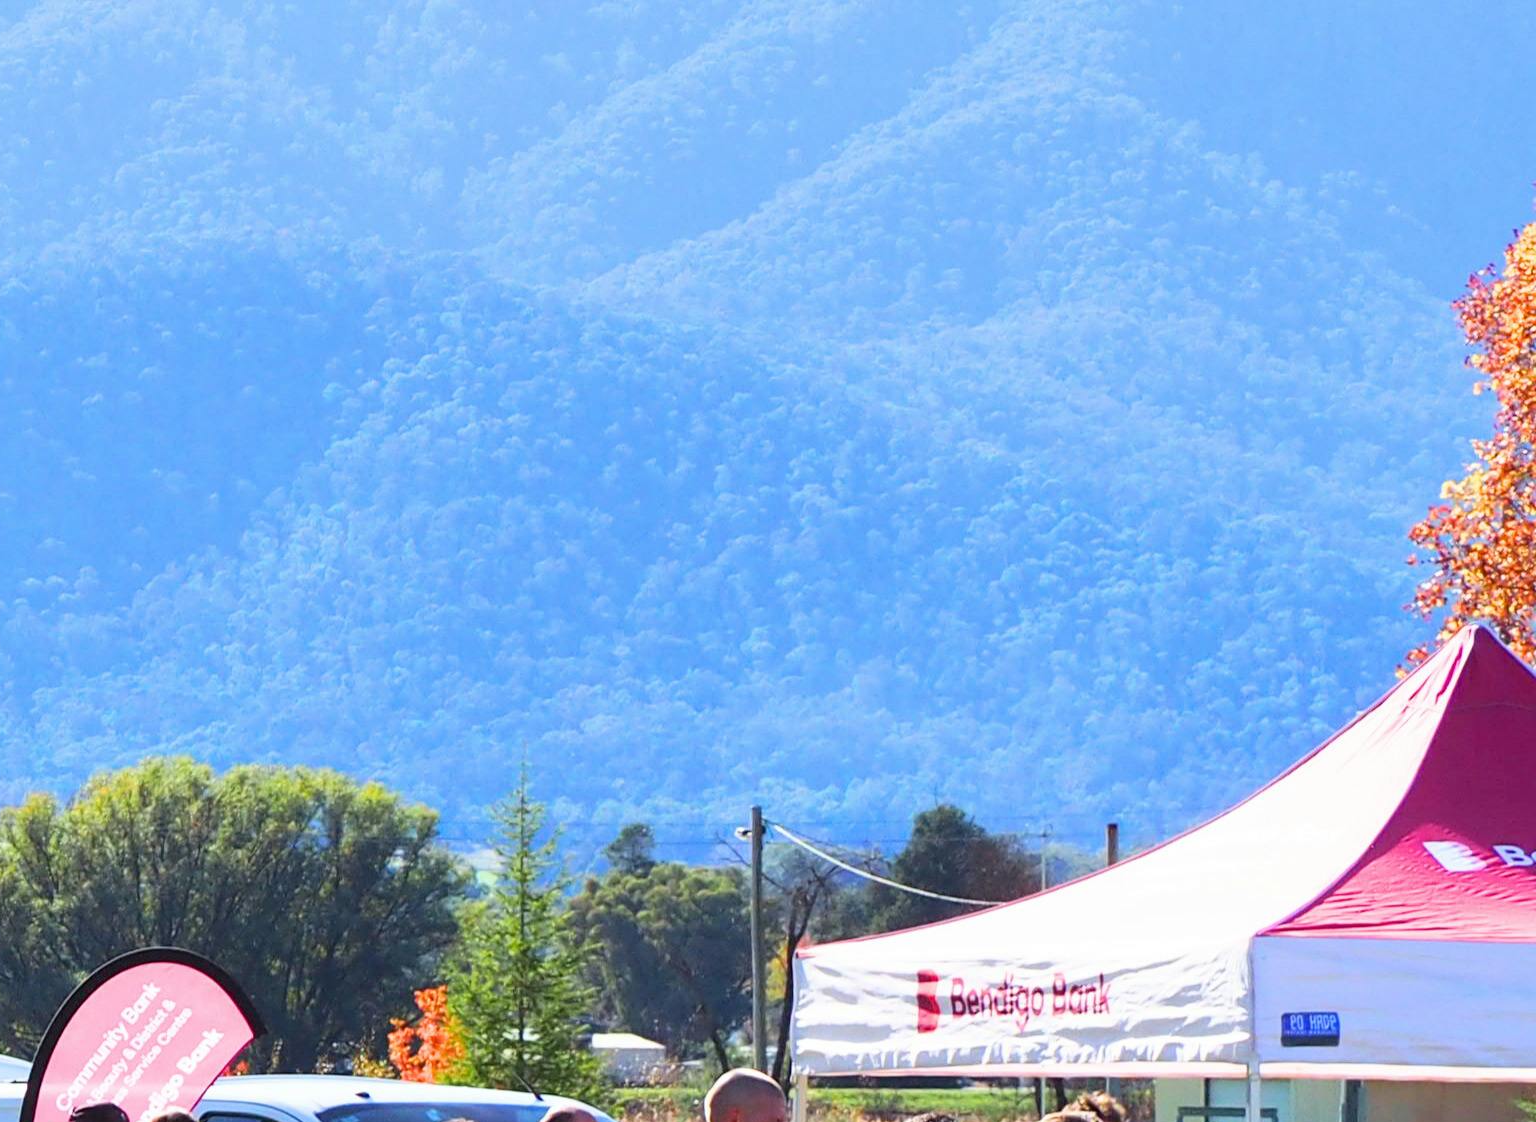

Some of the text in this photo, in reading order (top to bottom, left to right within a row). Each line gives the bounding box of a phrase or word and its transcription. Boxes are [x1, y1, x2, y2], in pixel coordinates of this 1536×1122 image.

[951, 972, 1044, 1033] Bendigo
[1053, 972, 1111, 1016] Bank
[55, 982, 161, 1112] Community Bank
[89, 1057, 129, 1101] Beauty
[130, 1009, 169, 1052] District
[127, 1007, 193, 1088] Service Centre
[176, 1028, 224, 1075] Bank
